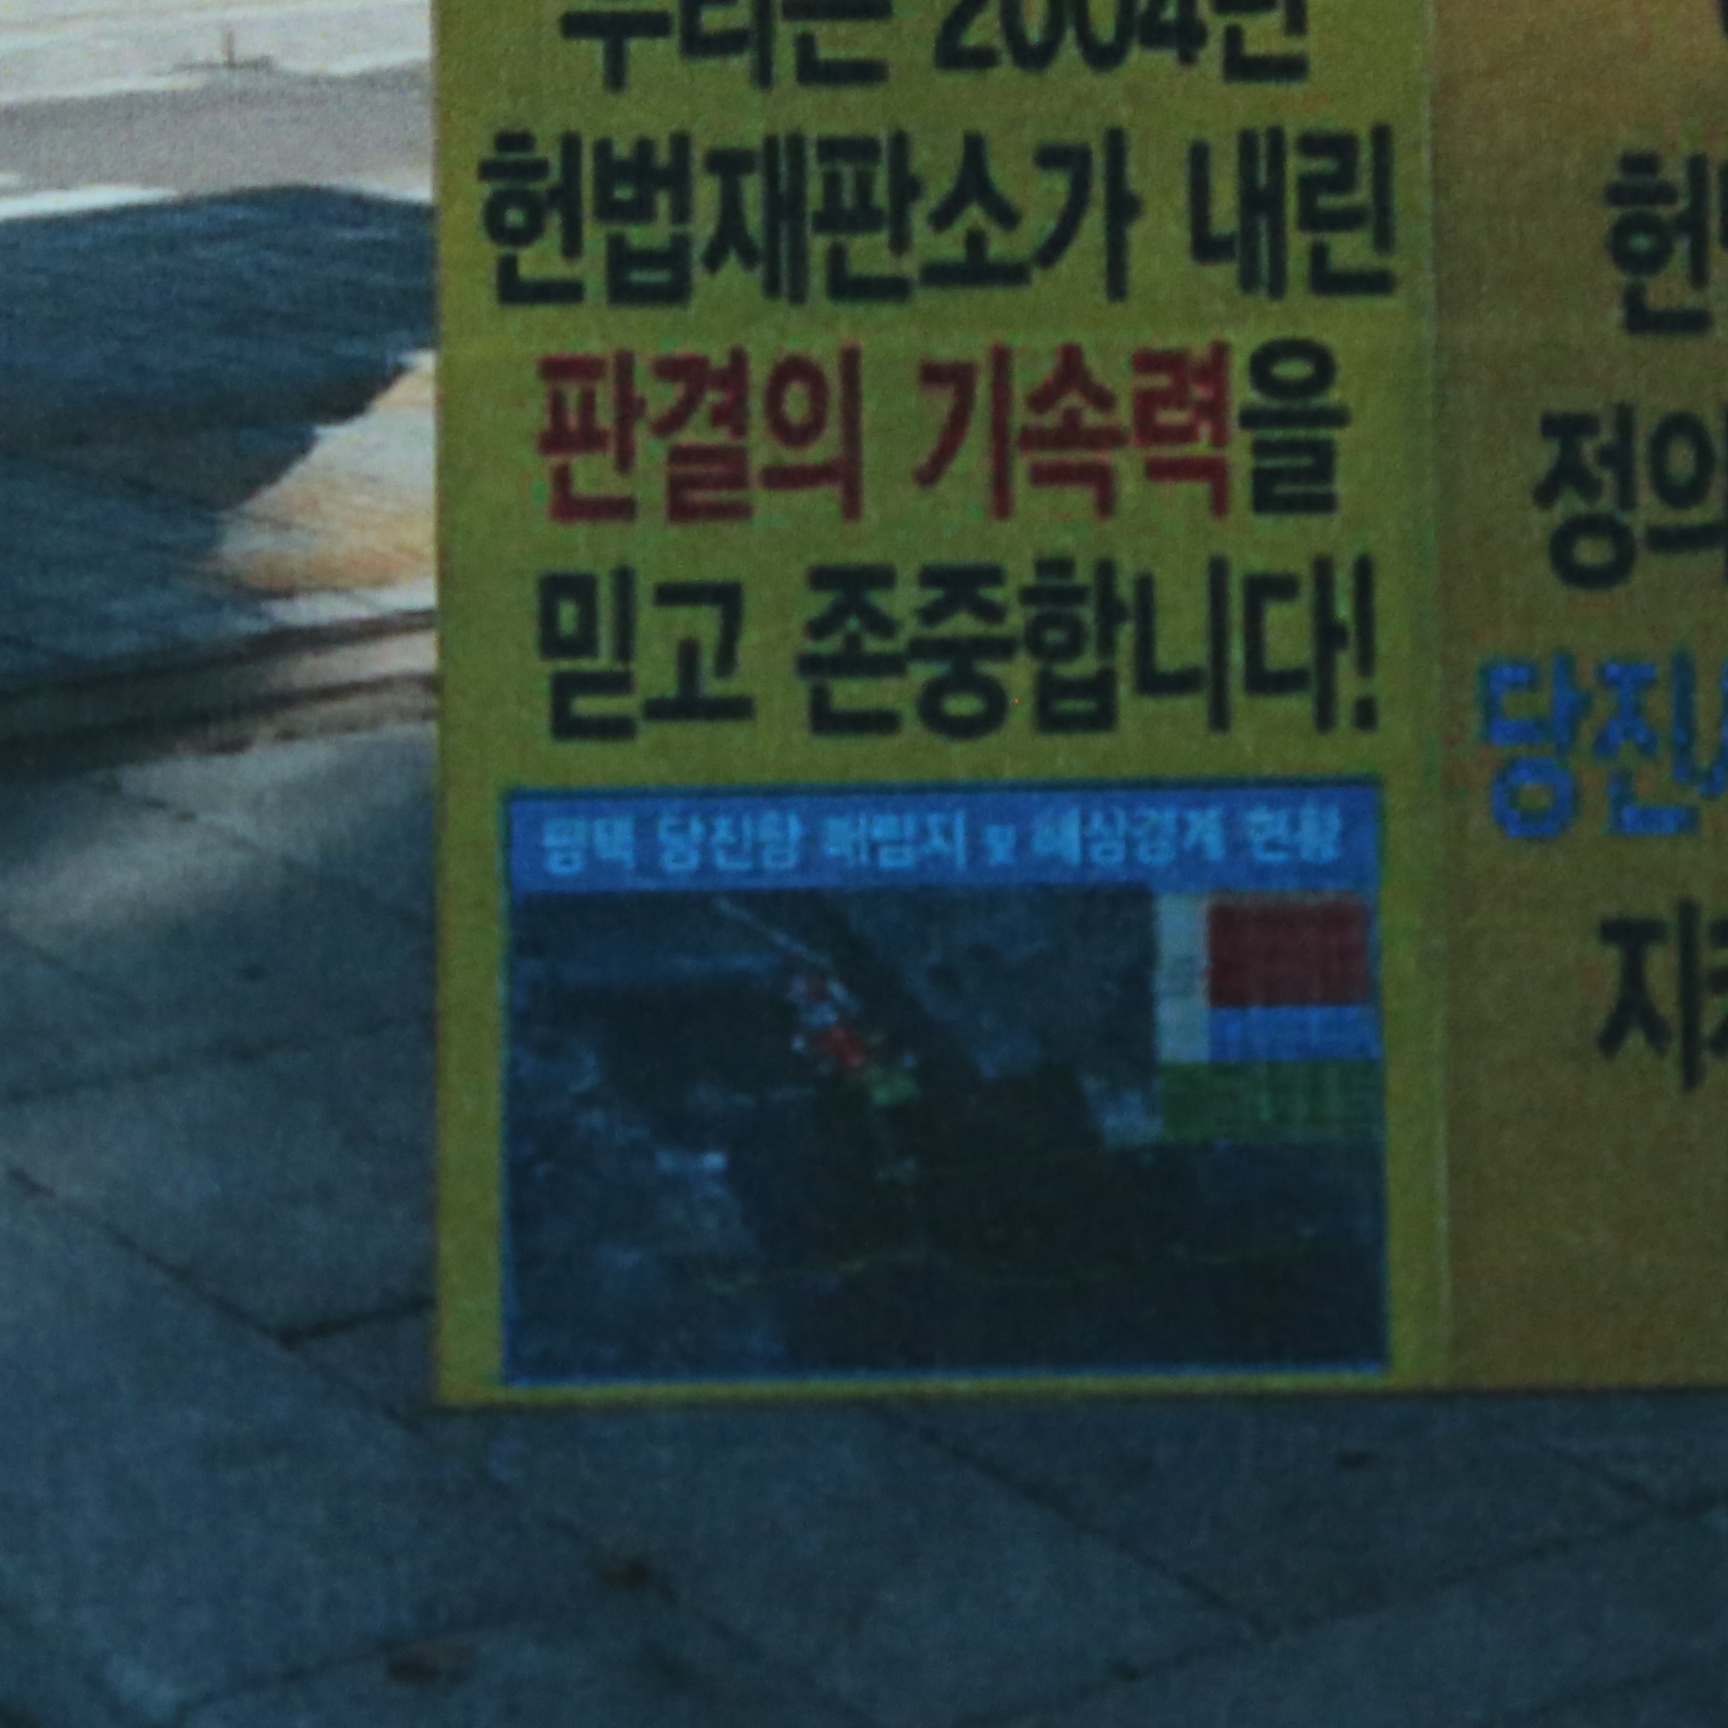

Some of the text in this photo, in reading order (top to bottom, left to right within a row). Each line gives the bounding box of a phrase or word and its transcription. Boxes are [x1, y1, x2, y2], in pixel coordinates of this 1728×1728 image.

[478, 123, 1396, 305] 헌법재판소가 내린
[537, 339, 1351, 522] 판결의 기속력을
[537, 554, 1377, 741] 믿고 존중합니다!
